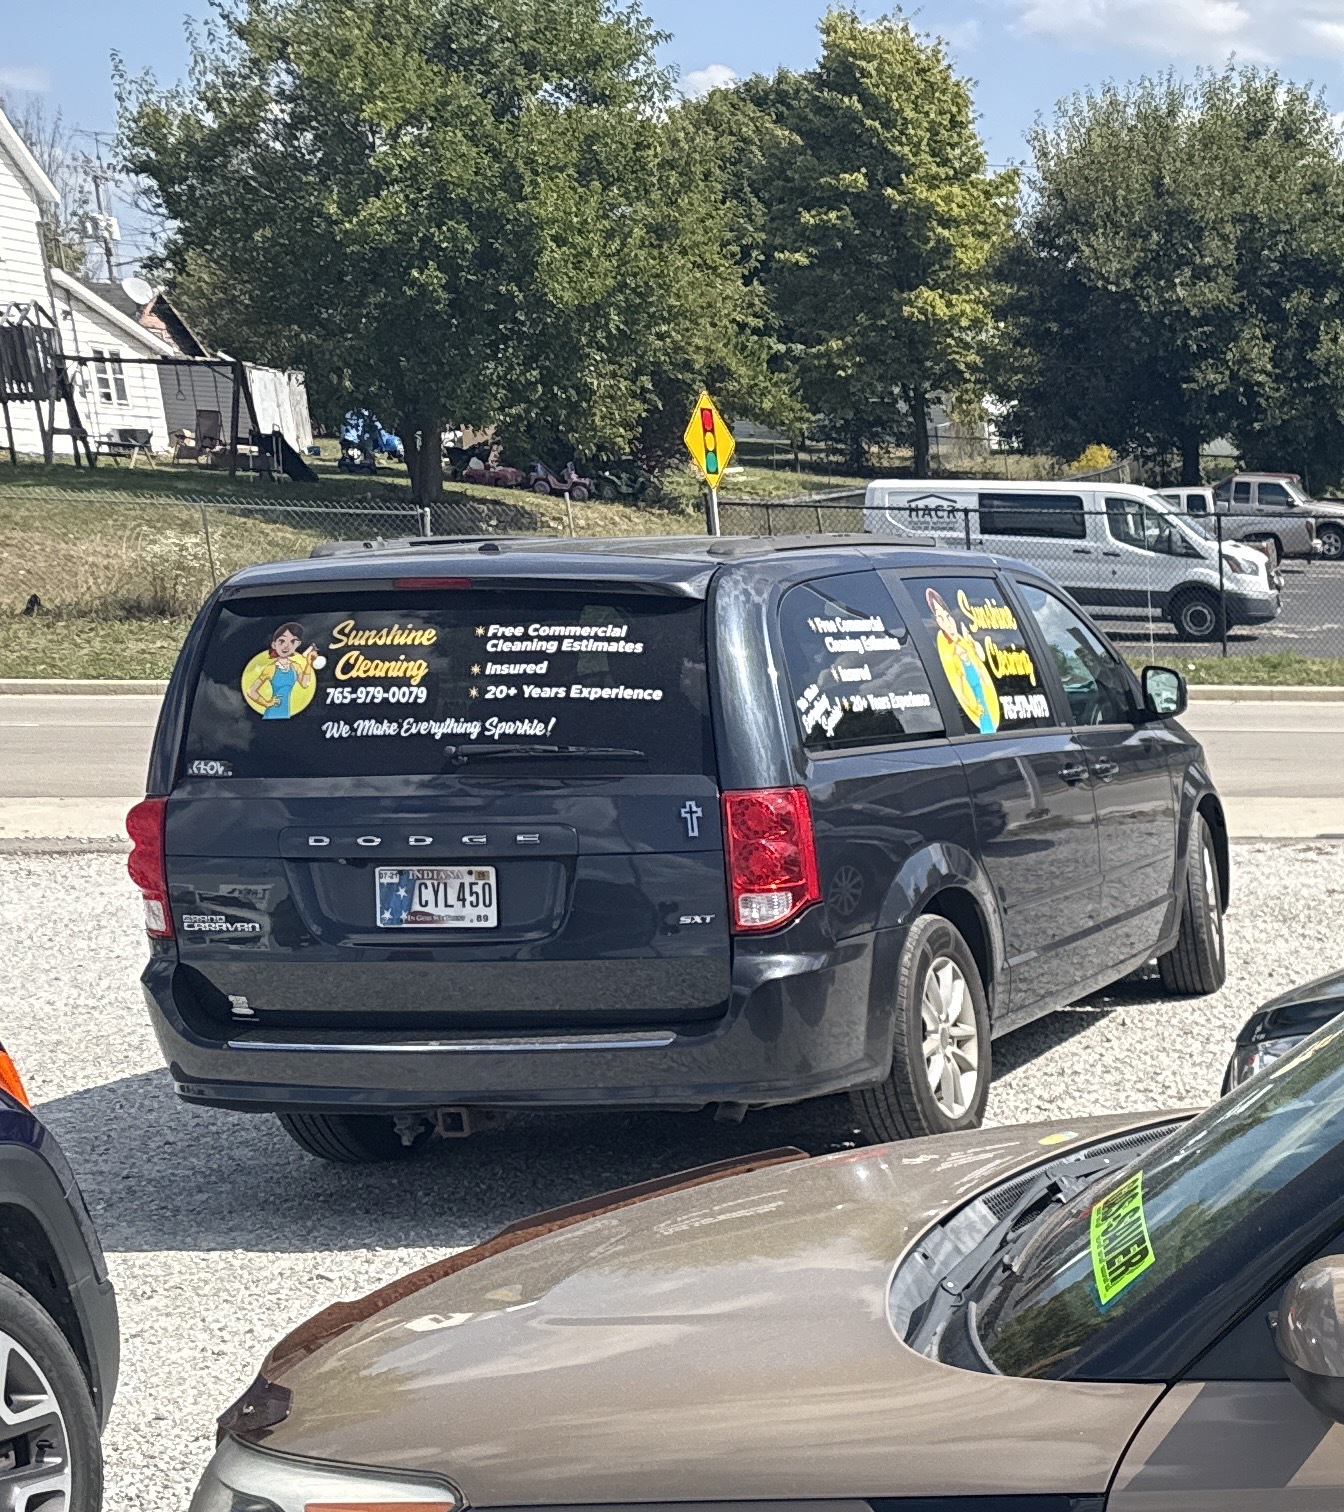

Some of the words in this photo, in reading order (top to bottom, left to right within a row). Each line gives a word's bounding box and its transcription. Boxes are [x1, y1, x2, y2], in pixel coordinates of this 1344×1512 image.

[908, 504, 957, 520] HACR
[328, 619, 438, 650] Sunshine
[488, 625, 524, 638] Free
[528, 624, 628, 638] Commercial
[486, 639, 559, 653] Cleaning
[561, 639, 644, 653] Estimates
[334, 650, 429, 686] Cleaning
[485, 660, 549, 675] Insured
[325, 686, 428, 704] 765-979-0079
[484, 685, 518, 699] 20+
[522, 684, 567, 698] Years
[569, 684, 663, 700] Experience
[321, 720, 350, 738] We
[353, 718, 399, 736] Make
[401, 717, 483, 740] Everything
[484, 716, 557, 740] Sparkle!
[308, 833, 541, 846] DODGE
[408, 869, 463, 880] INDIANA
[182, 914, 226, 923] GRAND
[679, 914, 716, 924] SXT
[183, 922, 260, 932] CARAVAN
